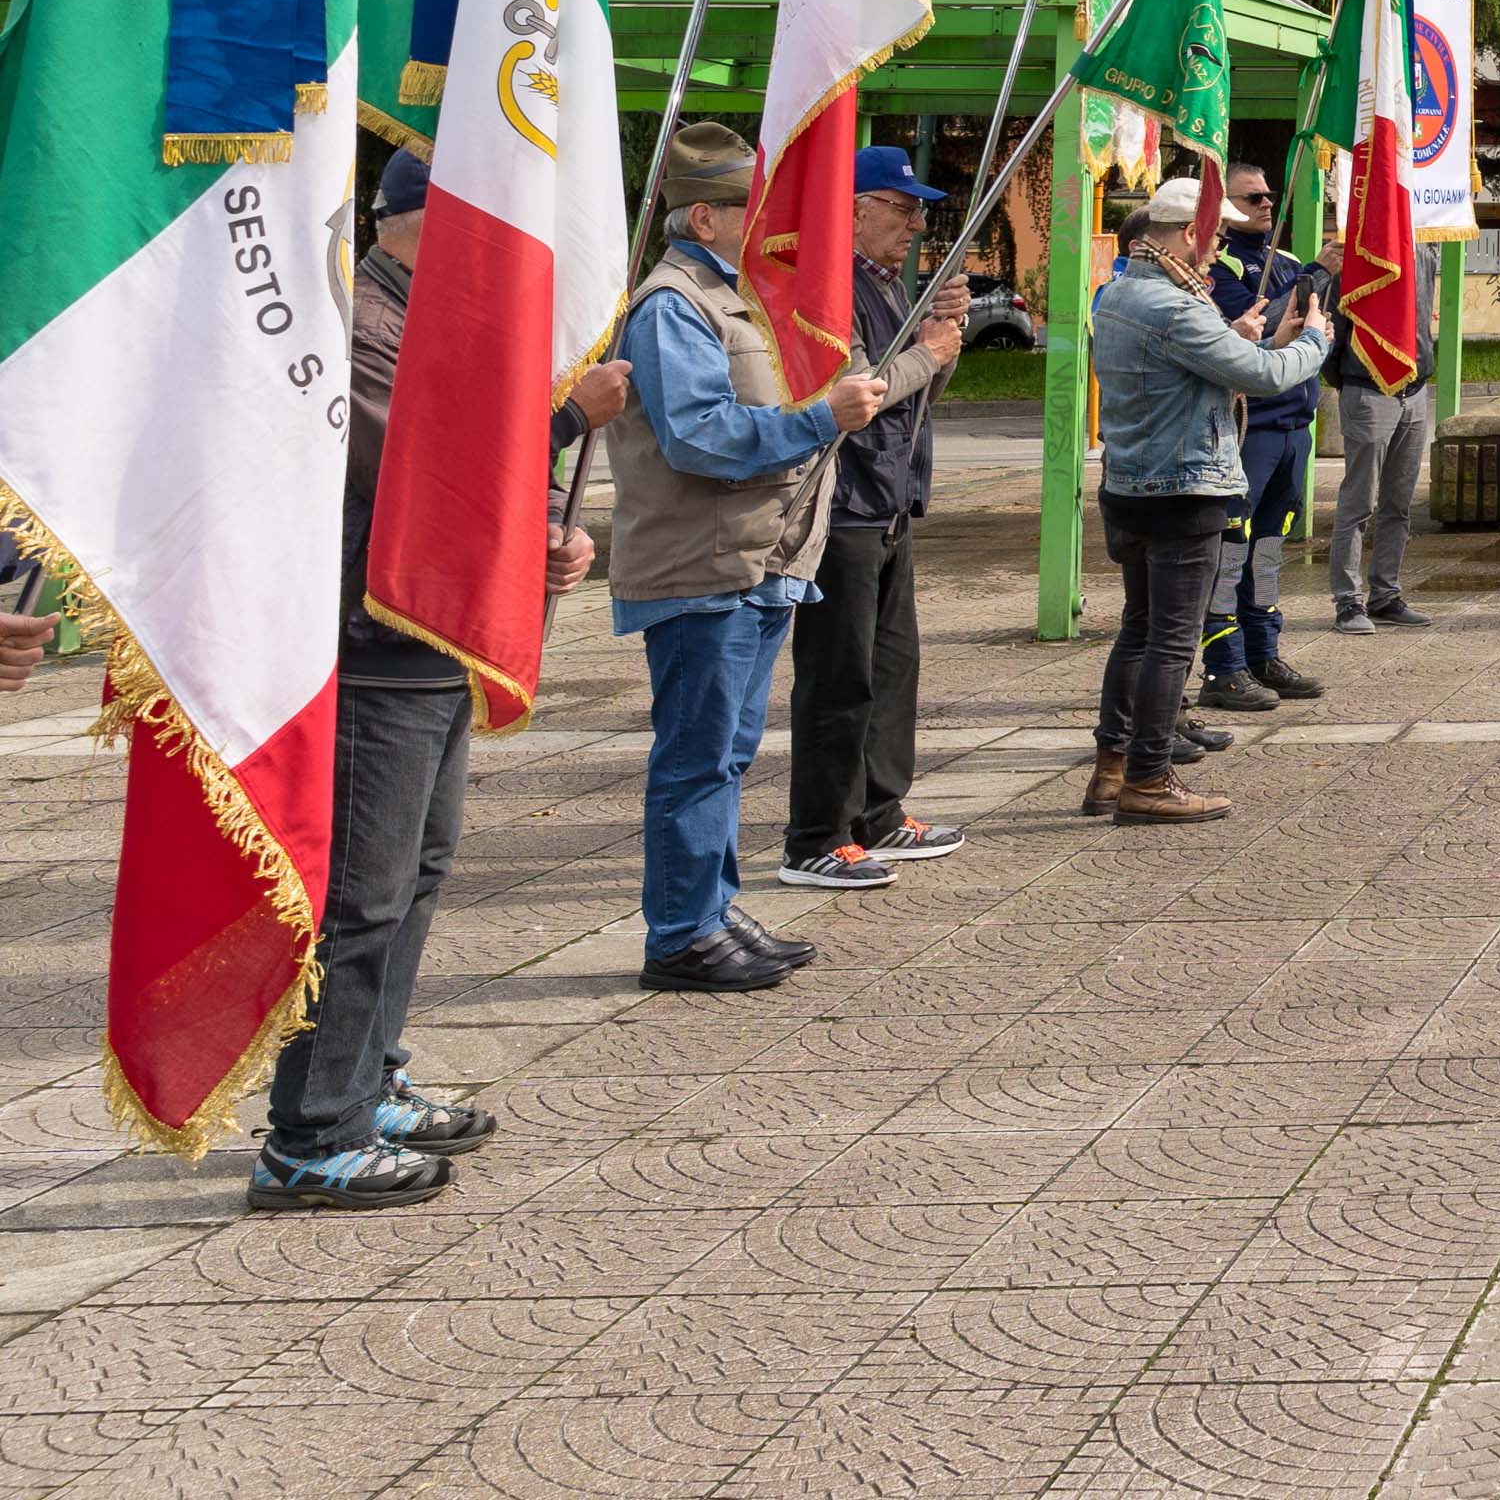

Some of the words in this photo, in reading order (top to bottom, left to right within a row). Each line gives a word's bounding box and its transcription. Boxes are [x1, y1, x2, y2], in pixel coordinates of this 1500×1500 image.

[1412, 123, 1450, 160] COMUNALE
[224, 185, 293, 337] SESTO
[287, 352, 325, 397] S.
